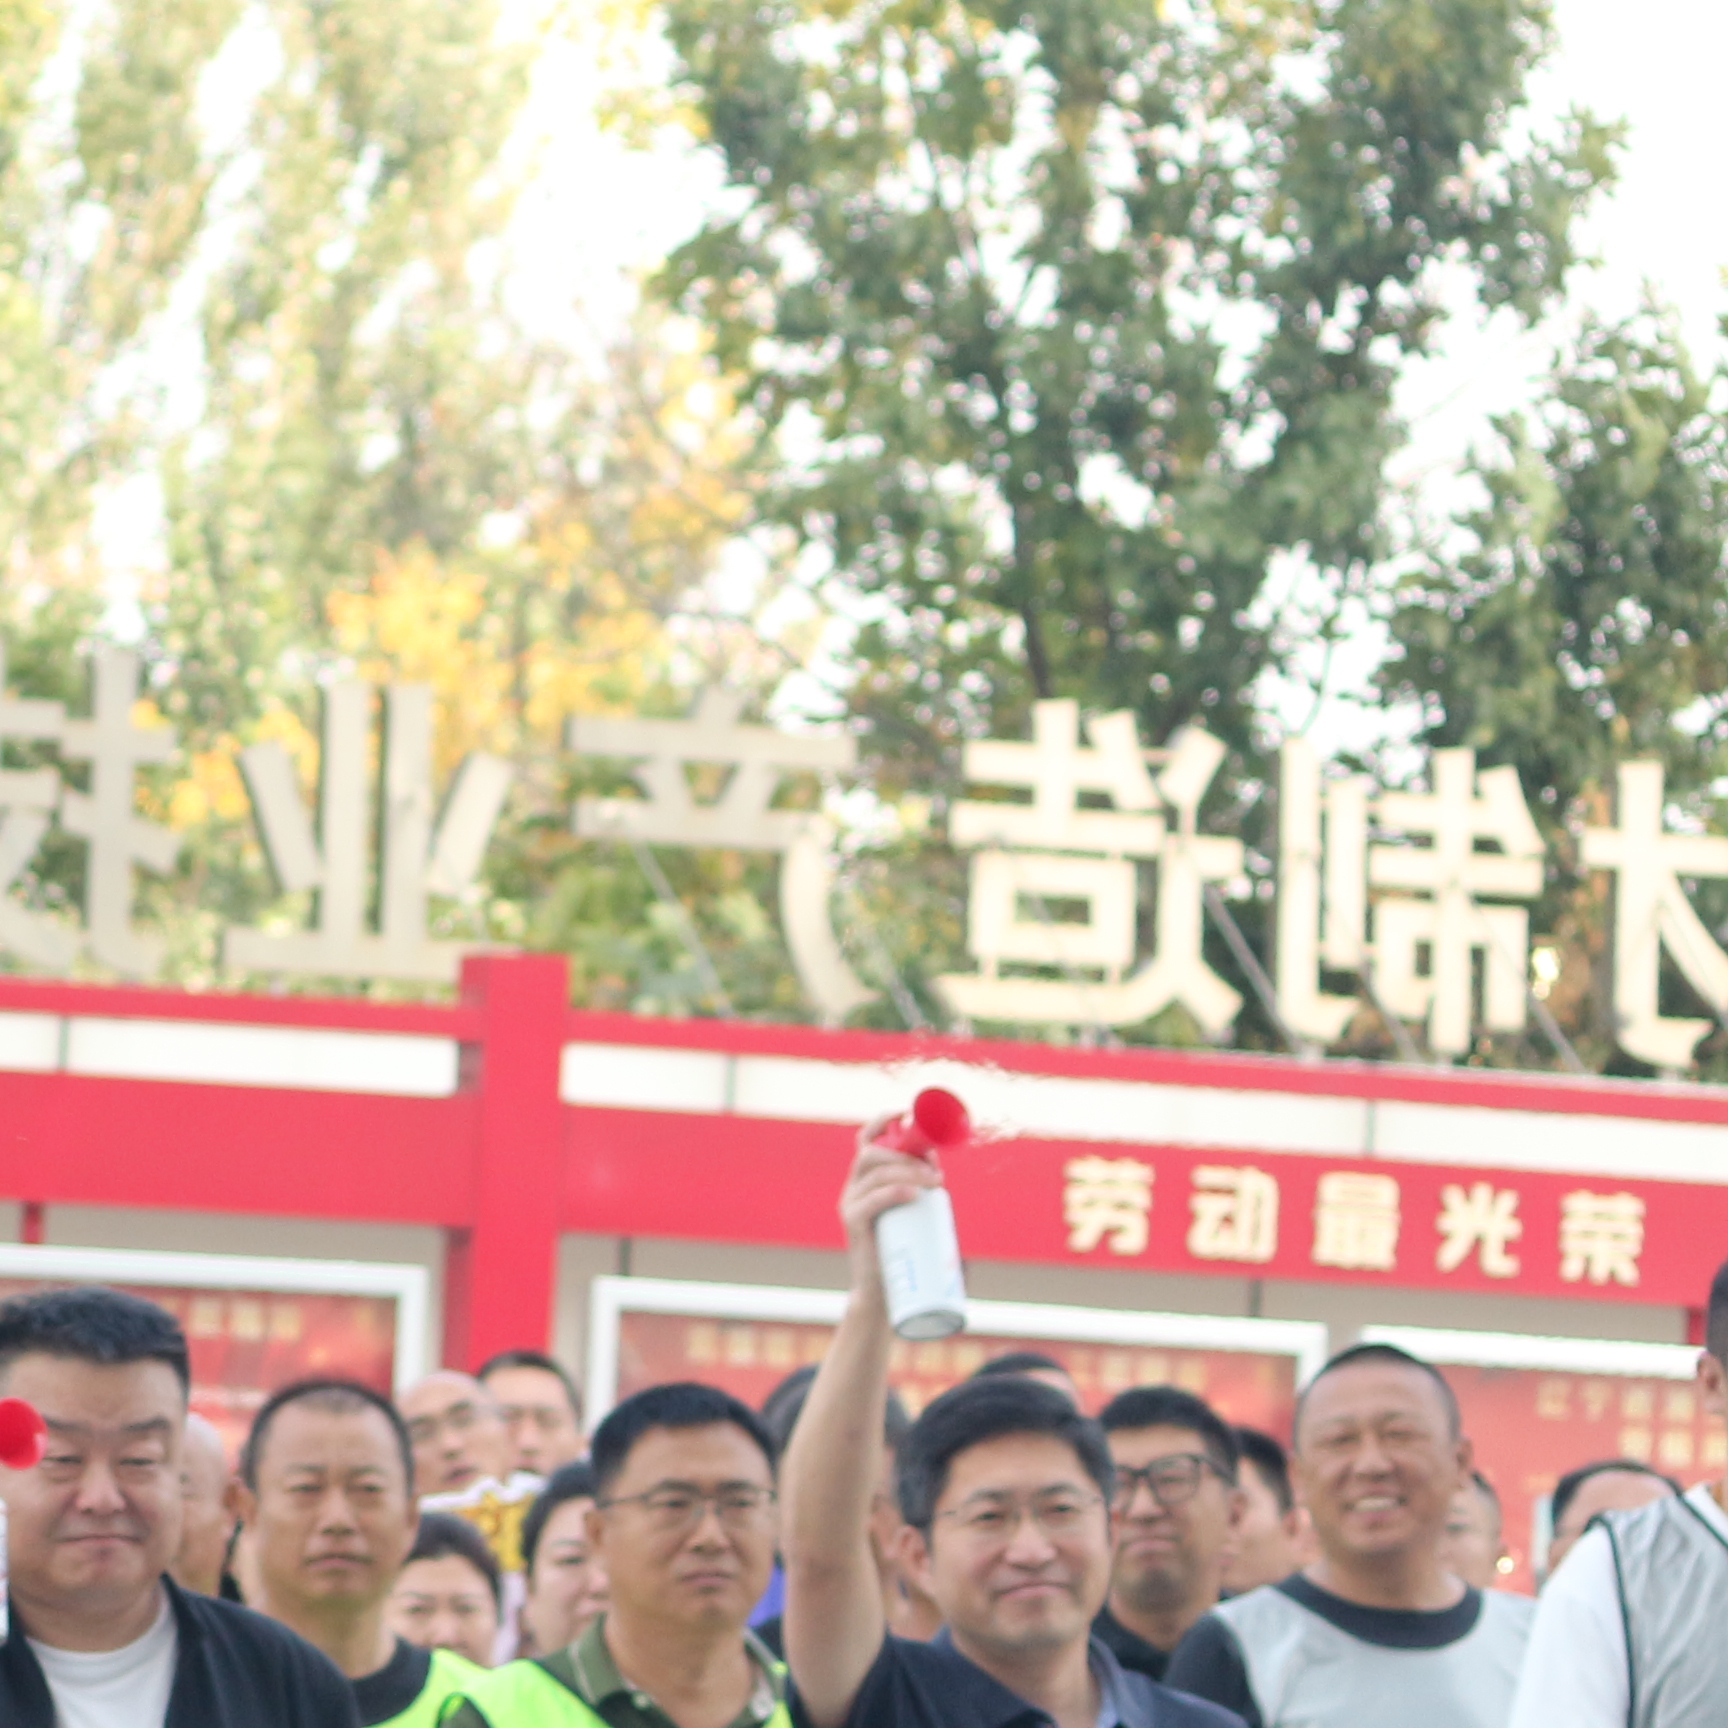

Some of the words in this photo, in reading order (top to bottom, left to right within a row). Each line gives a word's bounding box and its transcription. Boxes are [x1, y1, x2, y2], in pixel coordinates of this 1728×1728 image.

[1063, 1155, 1646, 1287] 劳动最光荣
